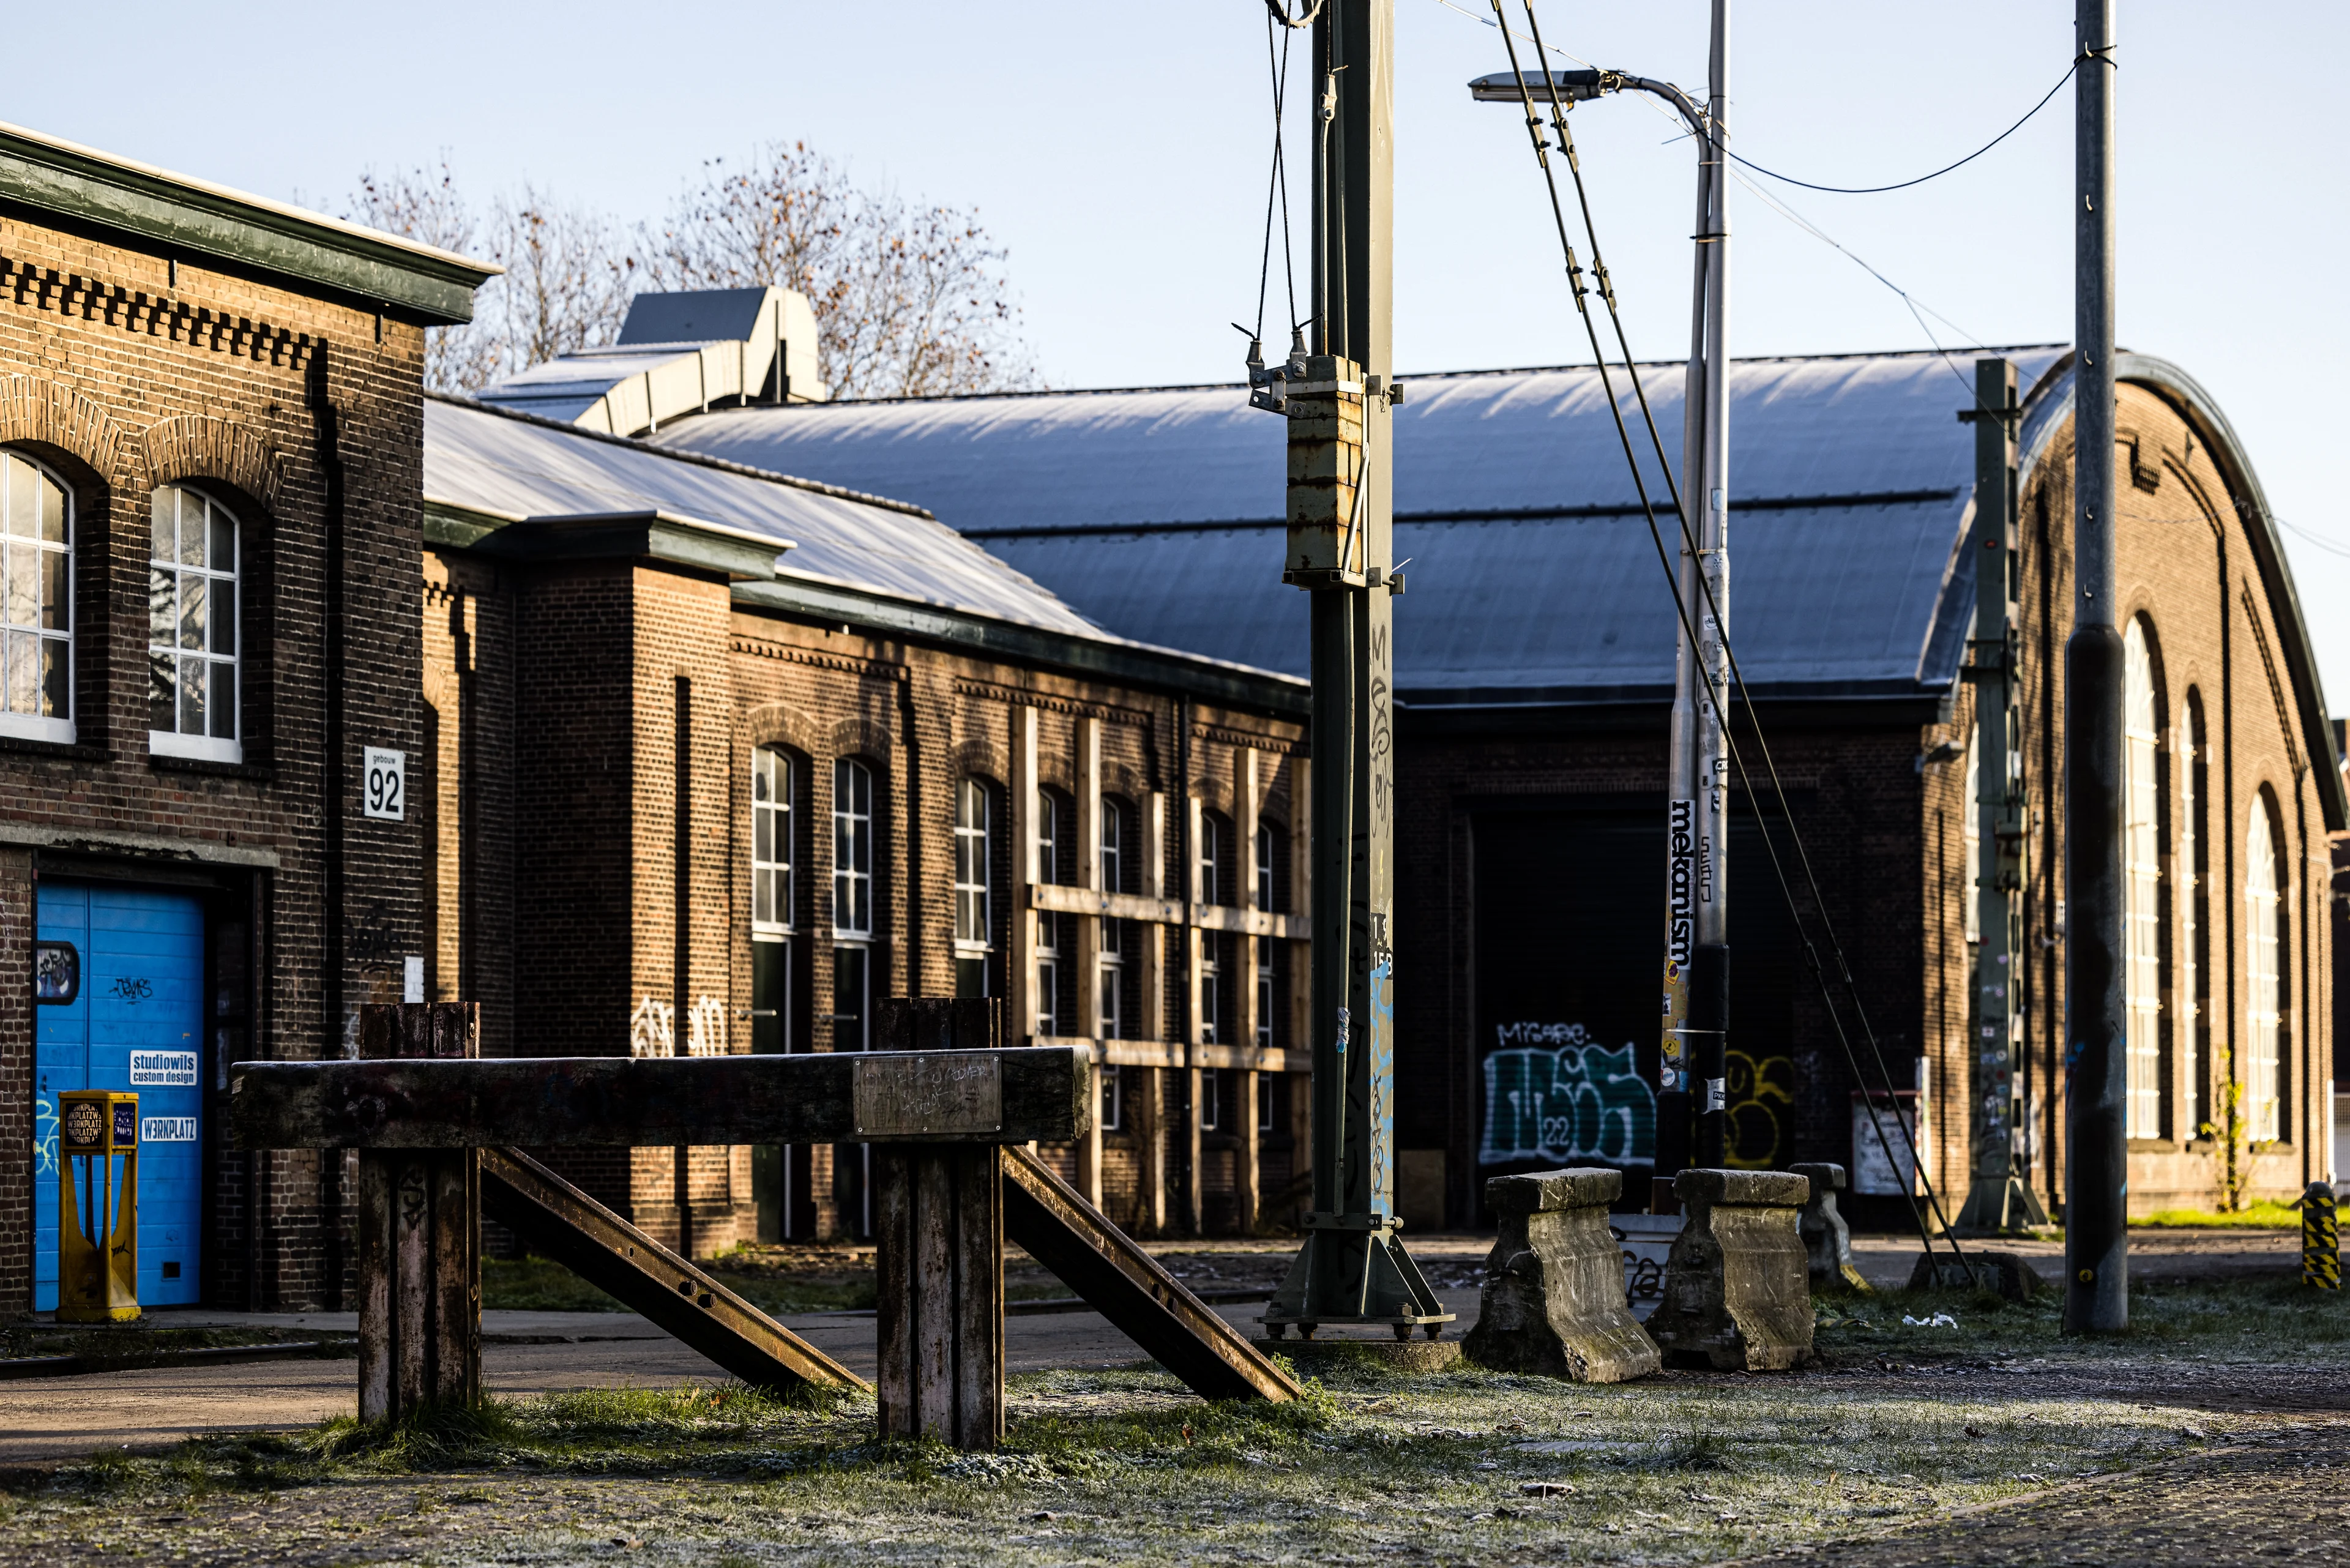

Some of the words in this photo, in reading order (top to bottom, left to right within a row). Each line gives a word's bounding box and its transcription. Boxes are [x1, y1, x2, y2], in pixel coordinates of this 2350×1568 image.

[373, 755, 396, 764] gebouw
[370, 768, 399, 813] 92
[1671, 801, 1695, 967] mekanism
[133, 1054, 194, 1070] studiowils
[133, 1072, 164, 1082] custom
[166, 1071, 194, 1084] design
[144, 1119, 195, 1139] W3RKPLATZ
